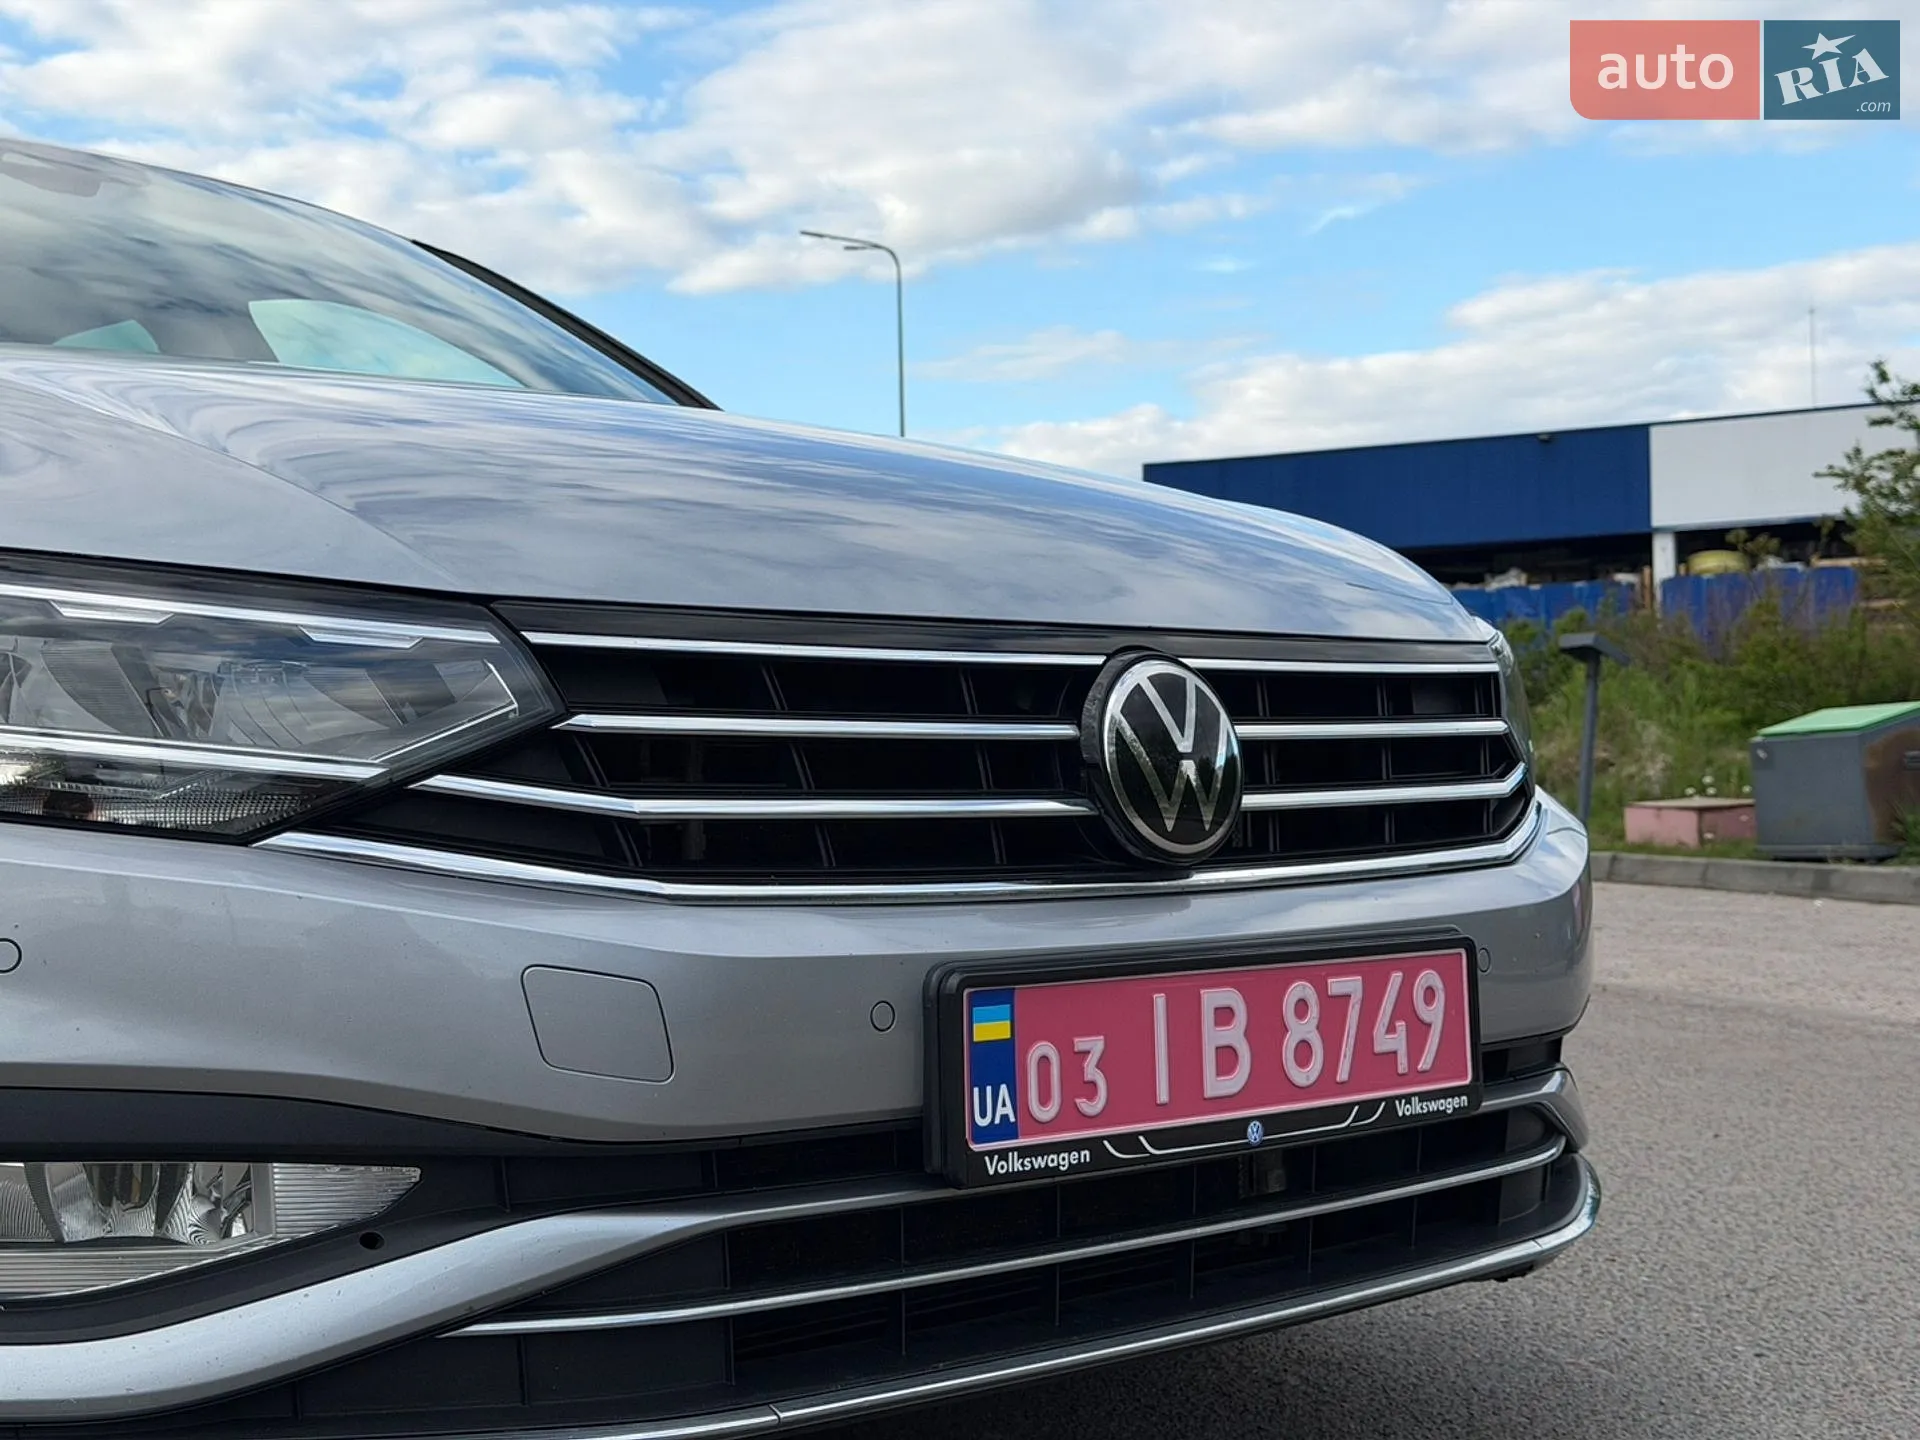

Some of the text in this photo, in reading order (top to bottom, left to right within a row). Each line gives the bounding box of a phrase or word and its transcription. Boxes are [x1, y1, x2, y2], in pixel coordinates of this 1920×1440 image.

[1026, 1035, 1107, 1124] 03
[1282, 968, 1447, 1088] 8749
[973, 1083, 1016, 1127] UA
[1395, 1094, 1469, 1117] Volkswagen
[984, 1148, 1091, 1176] Volkswagen
